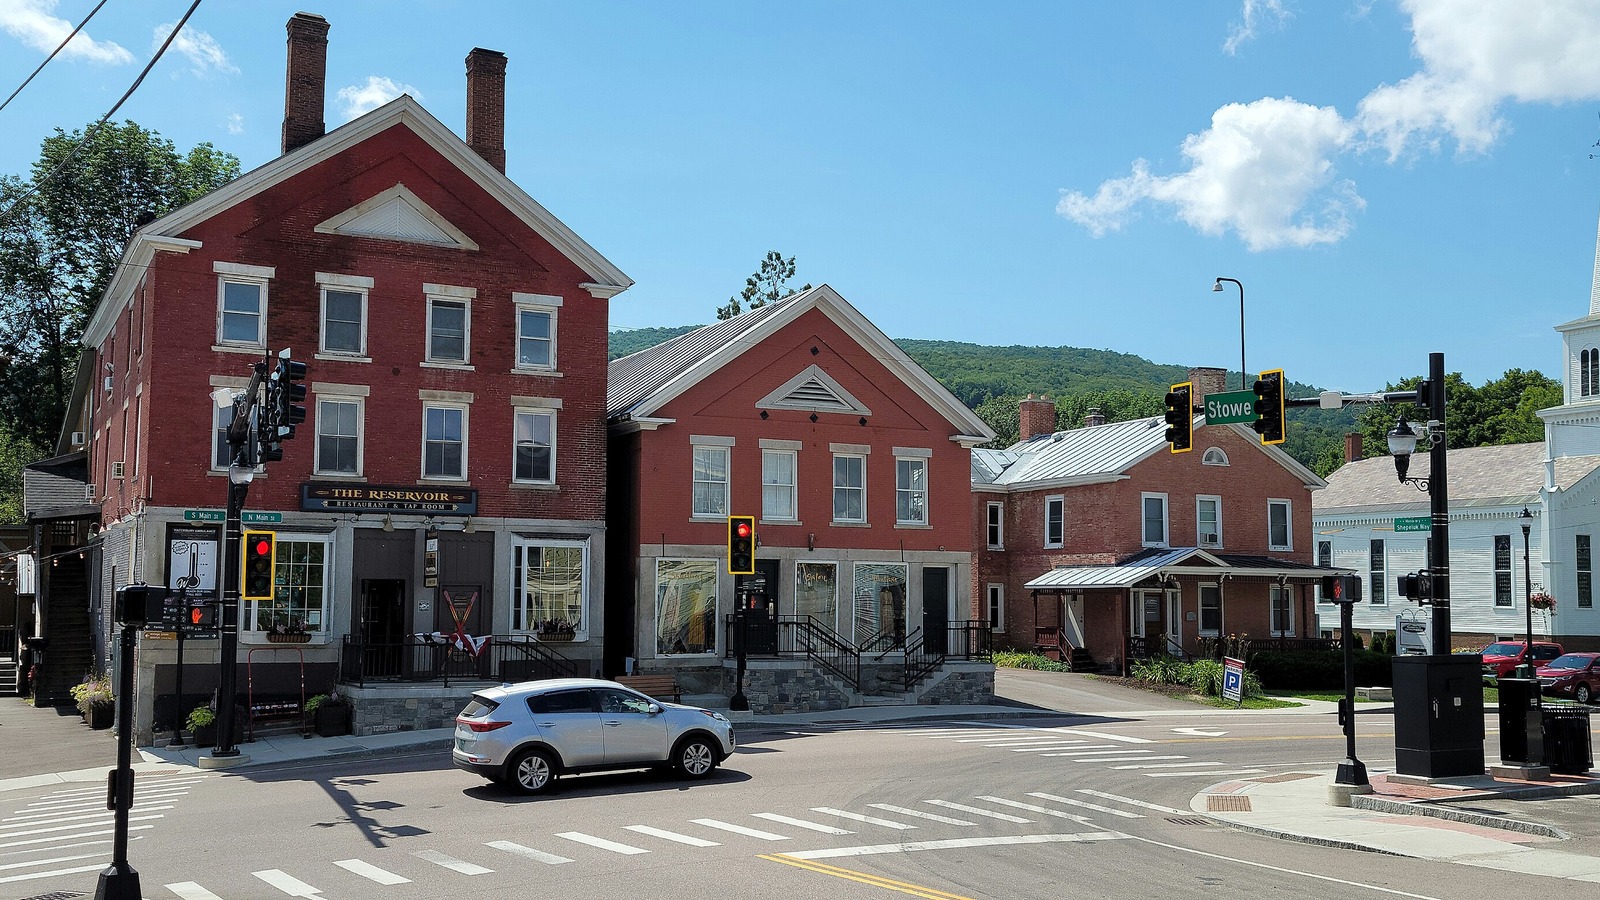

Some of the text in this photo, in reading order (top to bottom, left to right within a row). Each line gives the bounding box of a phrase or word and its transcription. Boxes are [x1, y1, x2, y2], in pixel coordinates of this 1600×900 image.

[1208, 400, 1251, 418] Stowe
[331, 488, 449, 501] THE RESERVOIR
[1229, 676, 1236, 686] P
